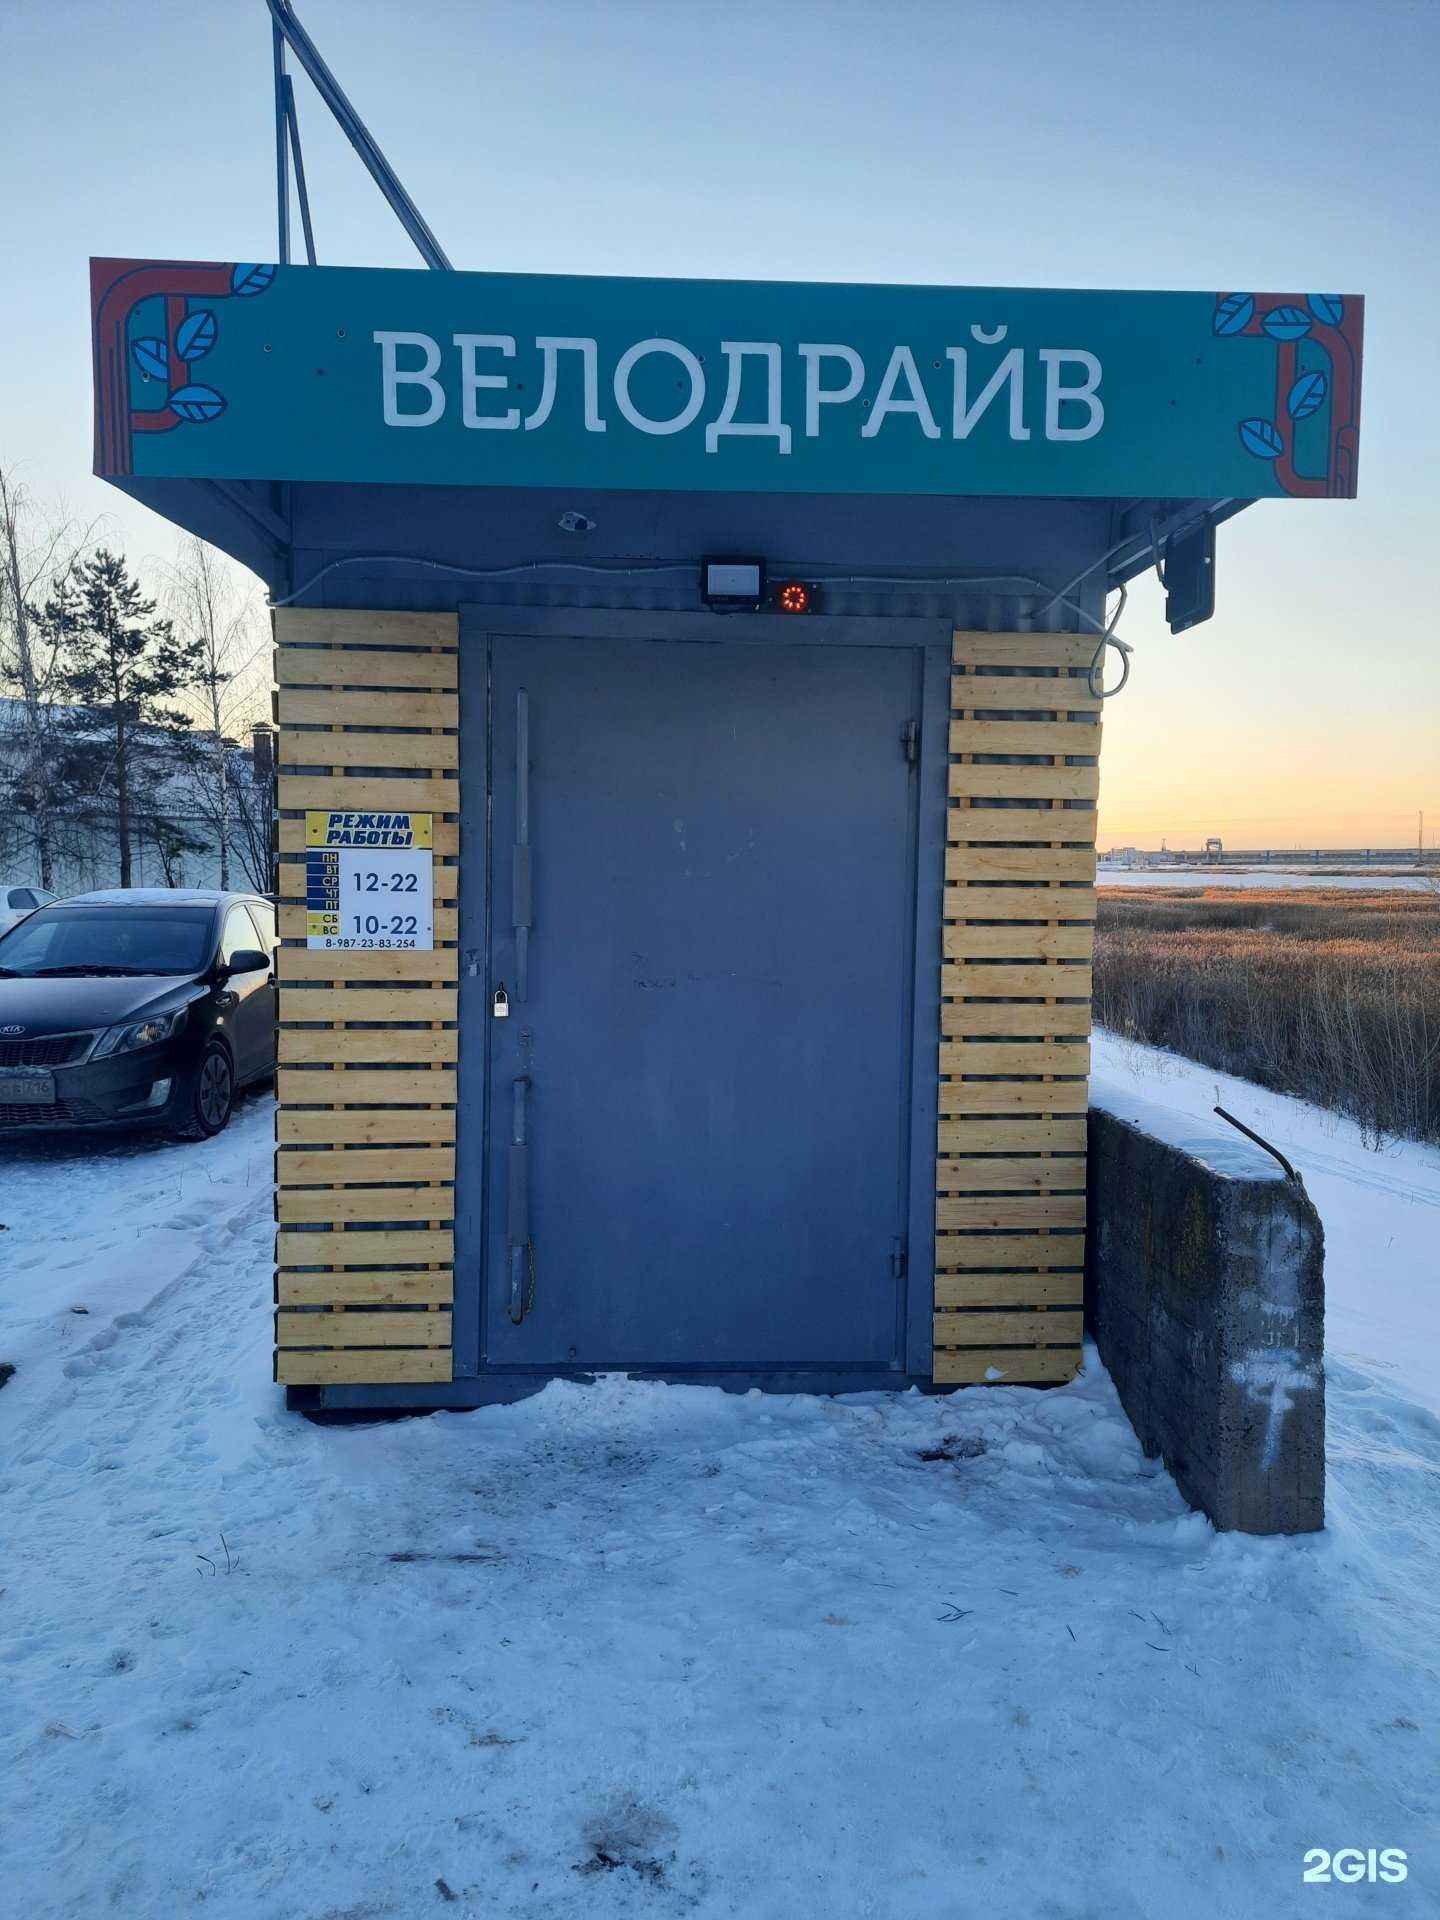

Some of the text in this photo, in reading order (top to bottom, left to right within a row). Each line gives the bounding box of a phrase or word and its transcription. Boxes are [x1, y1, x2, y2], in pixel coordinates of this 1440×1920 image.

[373, 324, 1105, 455] ВЕЛОДРАЙВ
[328, 814, 411, 830] РЕЖИМ
[326, 830, 414, 846] РАБОТЫ
[322, 854, 338, 863] ПН
[326, 865, 339, 874] ВТ
[322, 877, 338, 886] СР
[353, 872, 418, 892] 12-22
[328, 889, 339, 898] ЧТ
[325, 900, 339, 909] ПТ
[322, 914, 338, 923] СБ
[353, 915, 418, 935] 10-22
[322, 926, 338, 935] ВС
[325, 938, 416, 948] 8-987-23-83-254
